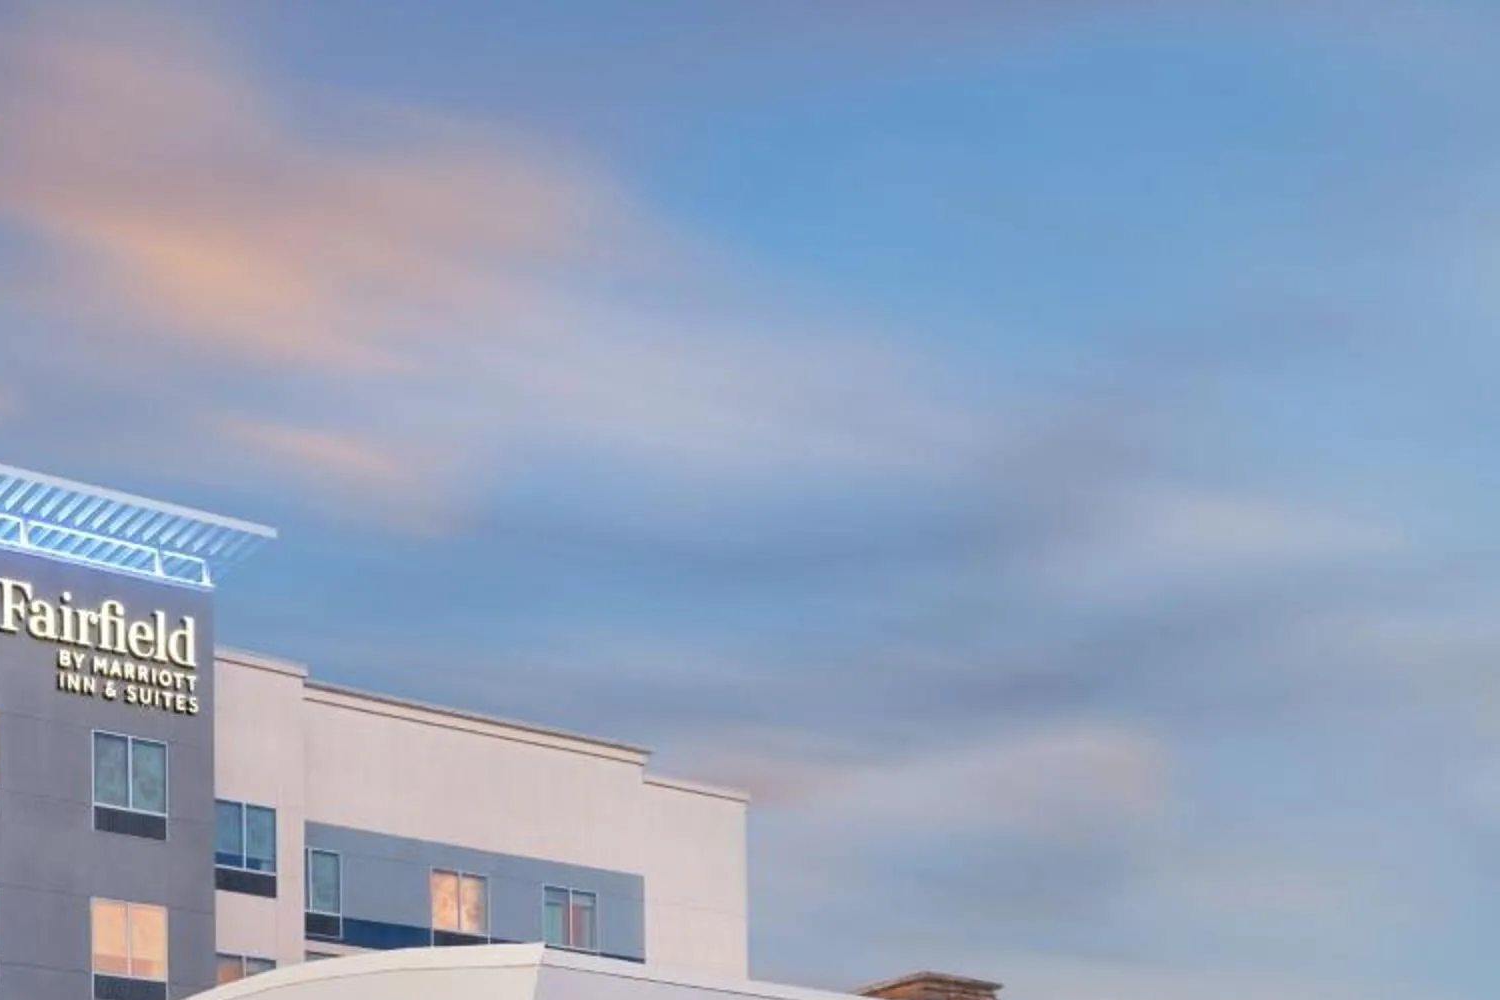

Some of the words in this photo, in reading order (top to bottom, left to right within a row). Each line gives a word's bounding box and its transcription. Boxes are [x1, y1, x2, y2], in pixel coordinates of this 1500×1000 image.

[58, 649, 85, 668] BY
[93, 654, 197, 691] MARRIOTT
[58, 672, 96, 693] INN
[105, 680, 117, 699] &
[126, 685, 199, 713] SUITES
